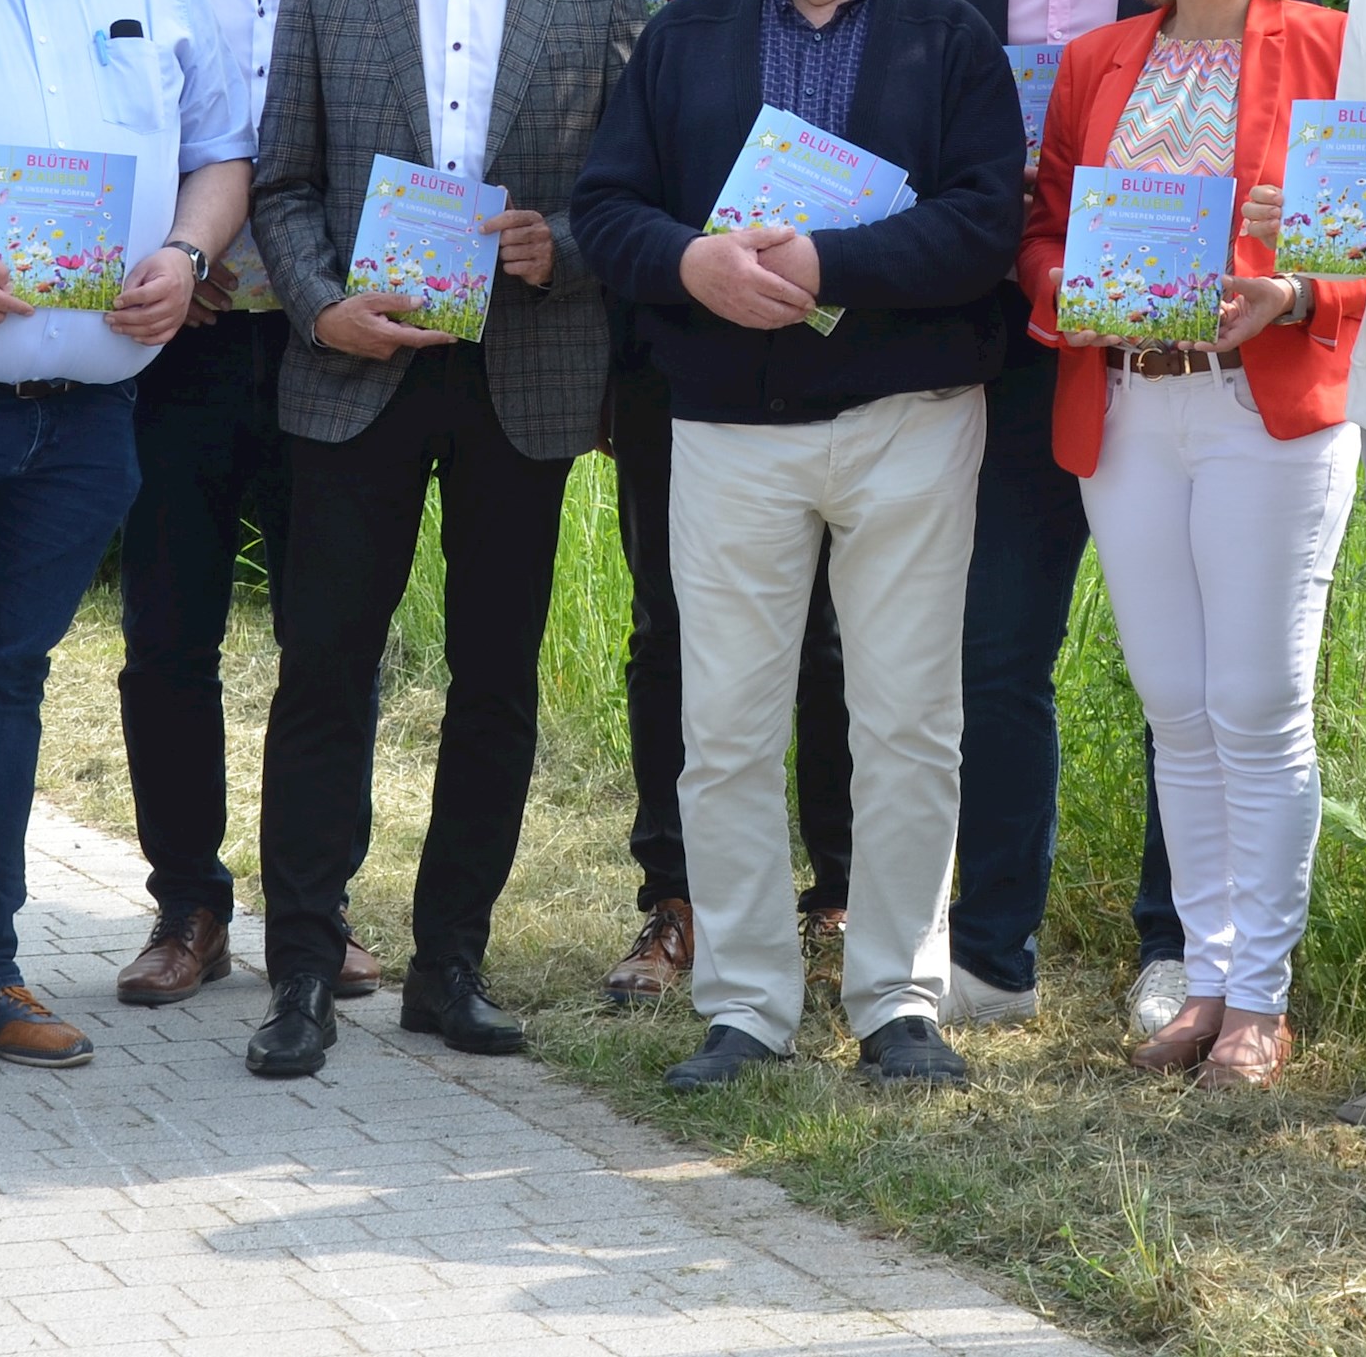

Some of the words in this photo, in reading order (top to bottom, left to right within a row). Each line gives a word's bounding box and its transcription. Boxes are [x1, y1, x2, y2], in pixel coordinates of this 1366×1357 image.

[1037, 50, 1063, 64] BLÜ
[798, 131, 860, 168] BLÜTEN
[26, 154, 90, 172] BLÜTEN
[792, 144, 852, 181] ZAUBER
[26, 170, 88, 186] ZAUBER
[410, 173, 465, 197] BLÜTEN
[1121, 177, 1186, 196] BLÜTEN
[408, 188, 463, 212] ZAUBER
[1120, 195, 1184, 212] ZAUBER
[1119, 211, 1155, 221] UNSEREN
[1156, 212, 1191, 224] DÖRFERN
